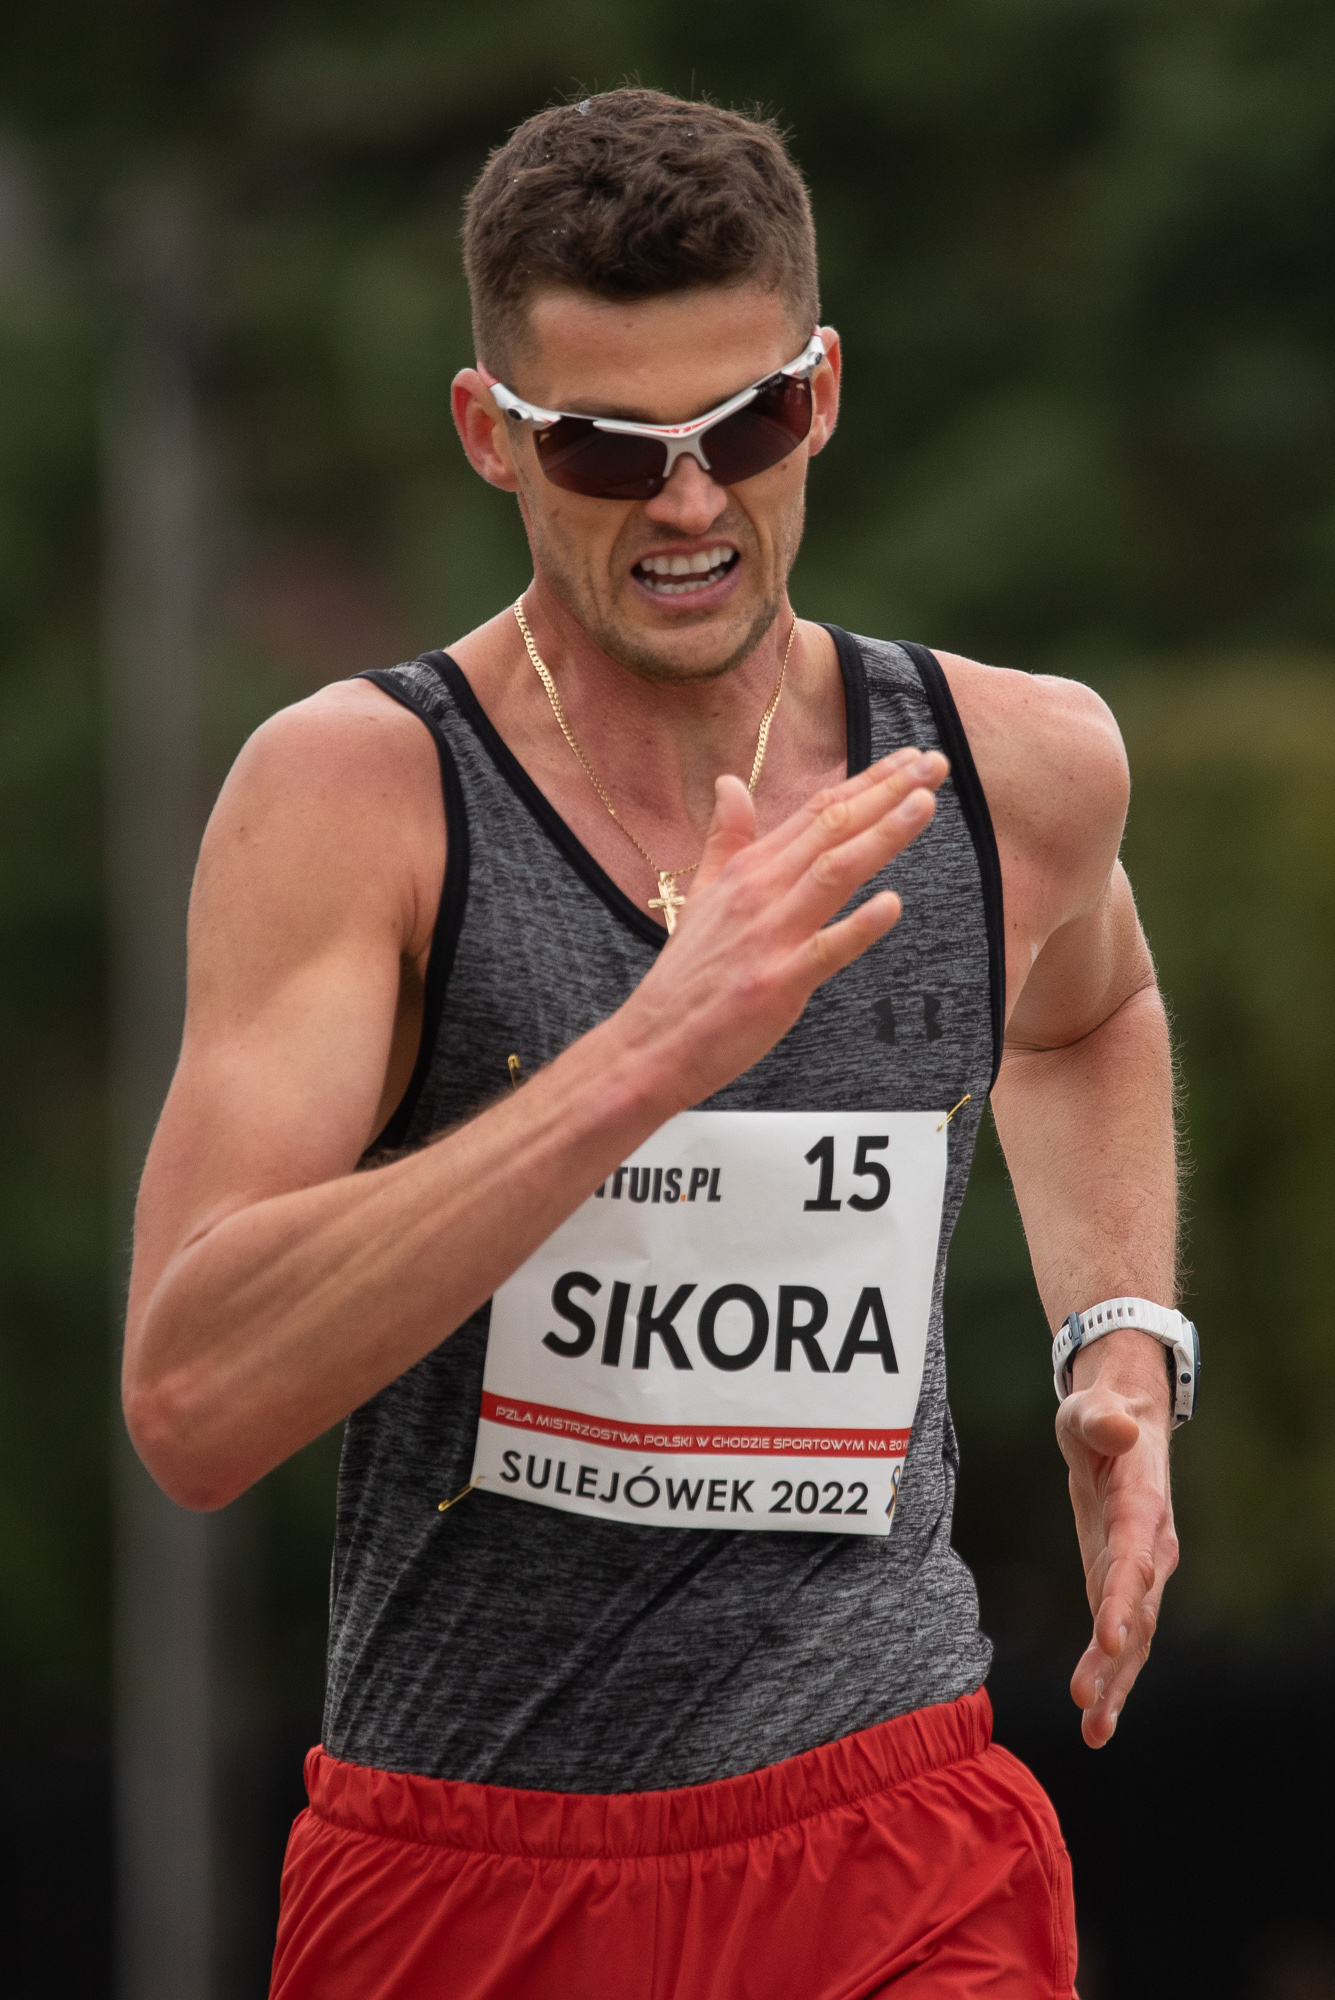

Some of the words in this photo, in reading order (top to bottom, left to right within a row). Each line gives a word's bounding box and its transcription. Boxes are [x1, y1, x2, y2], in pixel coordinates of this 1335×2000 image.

[802, 1135, 892, 1212] 15
[541, 1271, 900, 1374] SIKORA
[495, 1405, 533, 1424] PZLA
[536, 1414, 640, 1445] MISTRZOSTWA
[643, 1434, 692, 1448] POLSKI
[696, 1436, 711, 1448] W
[711, 1436, 770, 1449] CHODZIE
[772, 1437, 864, 1451] SPORTOWYM
[868, 1439, 887, 1451] NA
[500, 1450, 756, 1513] SULEJÓWEK
[768, 1481, 869, 1515] 2022
